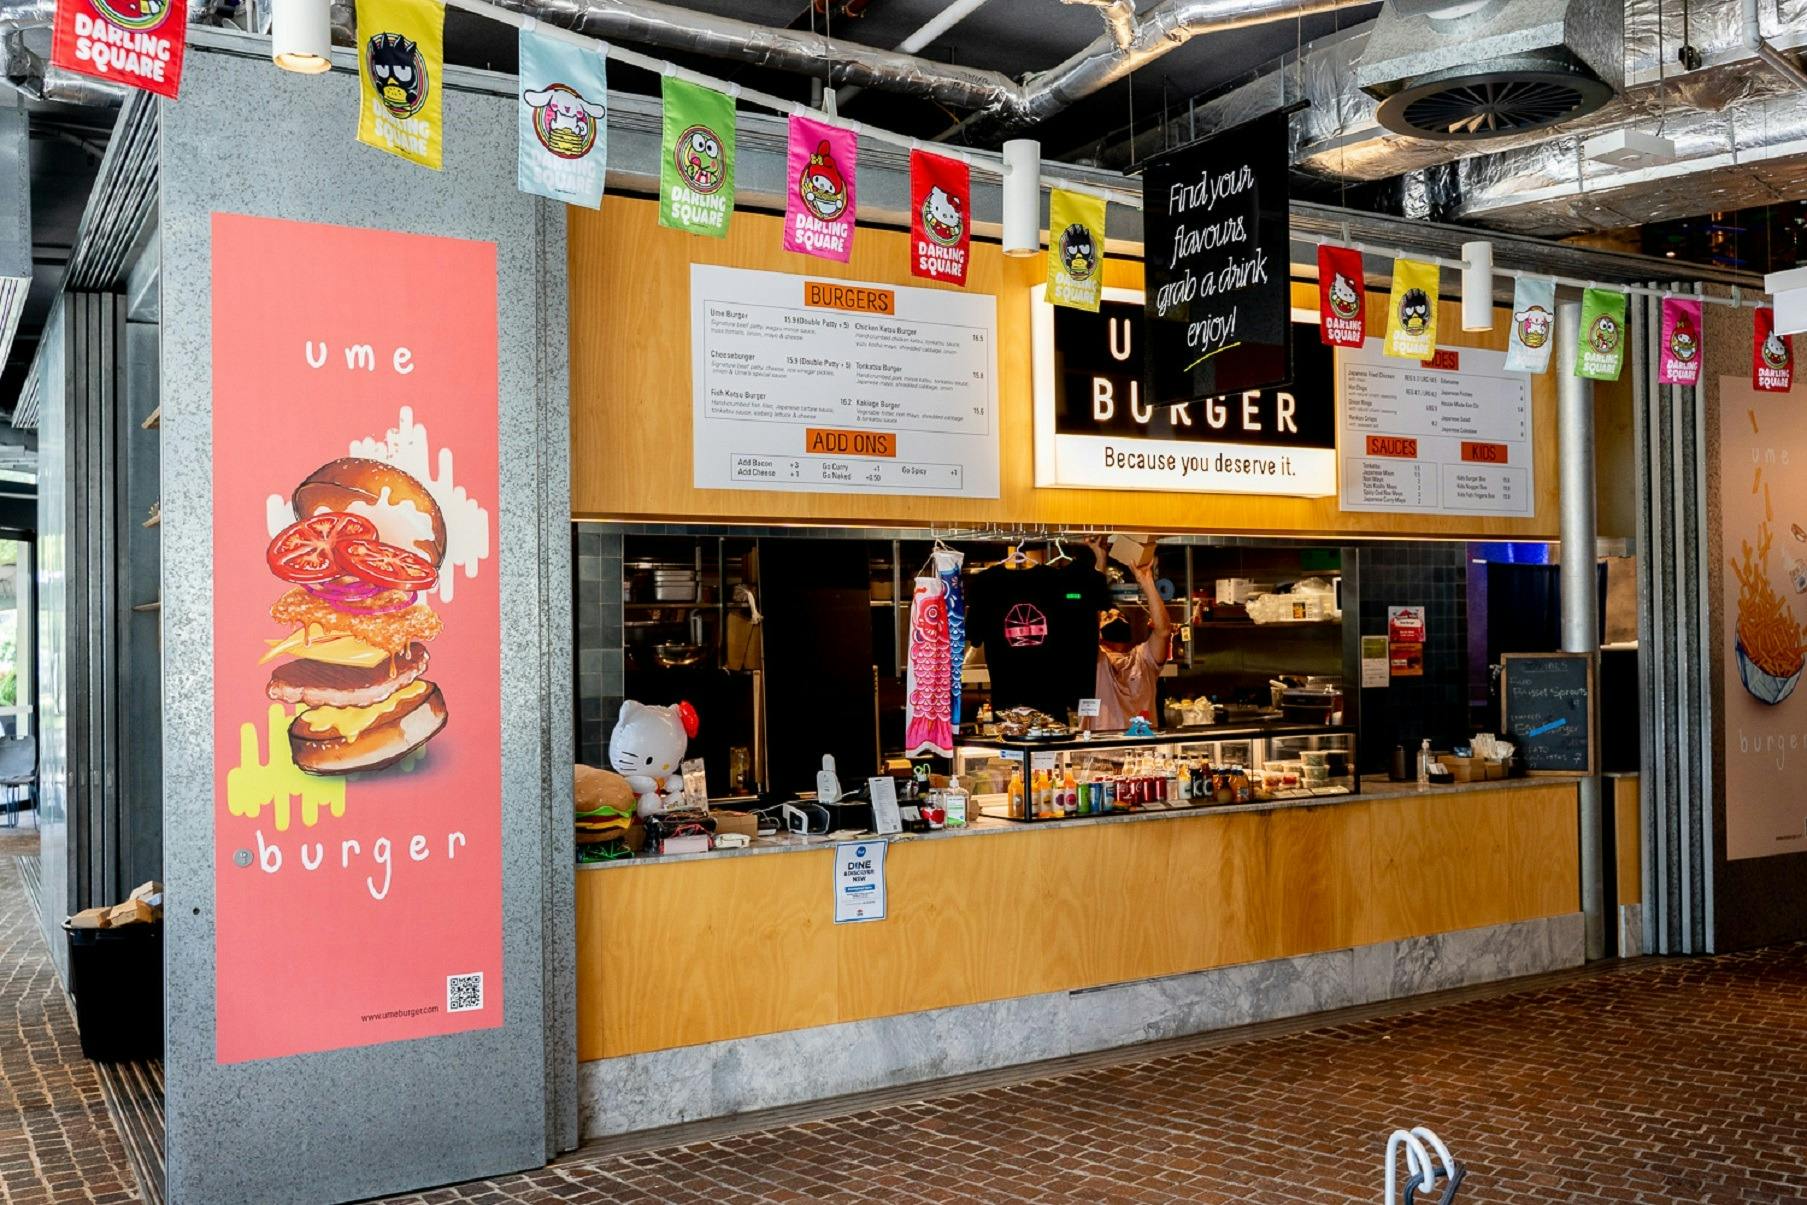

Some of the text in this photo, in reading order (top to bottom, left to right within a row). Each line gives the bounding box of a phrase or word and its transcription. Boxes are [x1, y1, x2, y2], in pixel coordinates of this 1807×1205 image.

[74, 12, 171, 62] DARLING
[75, 37, 165, 83] SQUARE
[374, 117, 428, 156] SQUARE
[671, 185, 726, 213] DARLING
[1169, 164, 1254, 216] Find your
[671, 204, 723, 228] SQUARE
[796, 213, 848, 238] DARLING
[795, 230, 844, 252] SQUARE
[1170, 216, 1248, 270] flavours,
[918, 241, 965, 264] DARLING
[919, 256, 962, 278] SQUARE
[810, 285, 888, 312] BURGERS
[1055, 284, 1095, 304] SQUARE
[1156, 269, 1197, 316] grab
[1200, 272, 1216, 298] a
[710, 308, 748, 320] Ume Burger
[854, 322, 879, 332] Chicken
[896, 326, 918, 336] Burger
[1187, 305, 1237, 352] enjoy!
[1326, 317, 1362, 332] DARLING
[1328, 328, 1360, 344] SQUARE
[305, 340, 414, 374] ume
[710, 350, 756, 362] Cheeseburger
[1583, 352, 1618, 366] DARLING
[1666, 360, 1698, 370] DARLING
[856, 362, 902, 374] Tonkatsu Burger
[1583, 362, 1616, 375] SQUARE
[1666, 368, 1696, 382] SQUARE
[1758, 367, 1790, 378] DARLING
[1758, 376, 1789, 388] SQUARE
[710, 388, 724, 396] Fish
[744, 390, 766, 400] Burger
[880, 400, 901, 410] Burger
[1092, 376, 1298, 434] BURGER
[812, 432, 888, 455] ADD ONS
[1371, 438, 1417, 456] SAUCES
[1105, 446, 1296, 476] Because you deserve it.
[1472, 444, 1497, 462] KIDS
[1752, 447, 1790, 465] ume
[737, 458, 751, 466] Add
[752, 458, 773, 468] Bacon
[737, 468, 776, 478] Add Cheese
[832, 472, 852, 480] Naked
[256, 830, 466, 900] burger
[848, 860, 872, 870] DINE
[361, 1005, 439, 1022] www.umeburger.com
